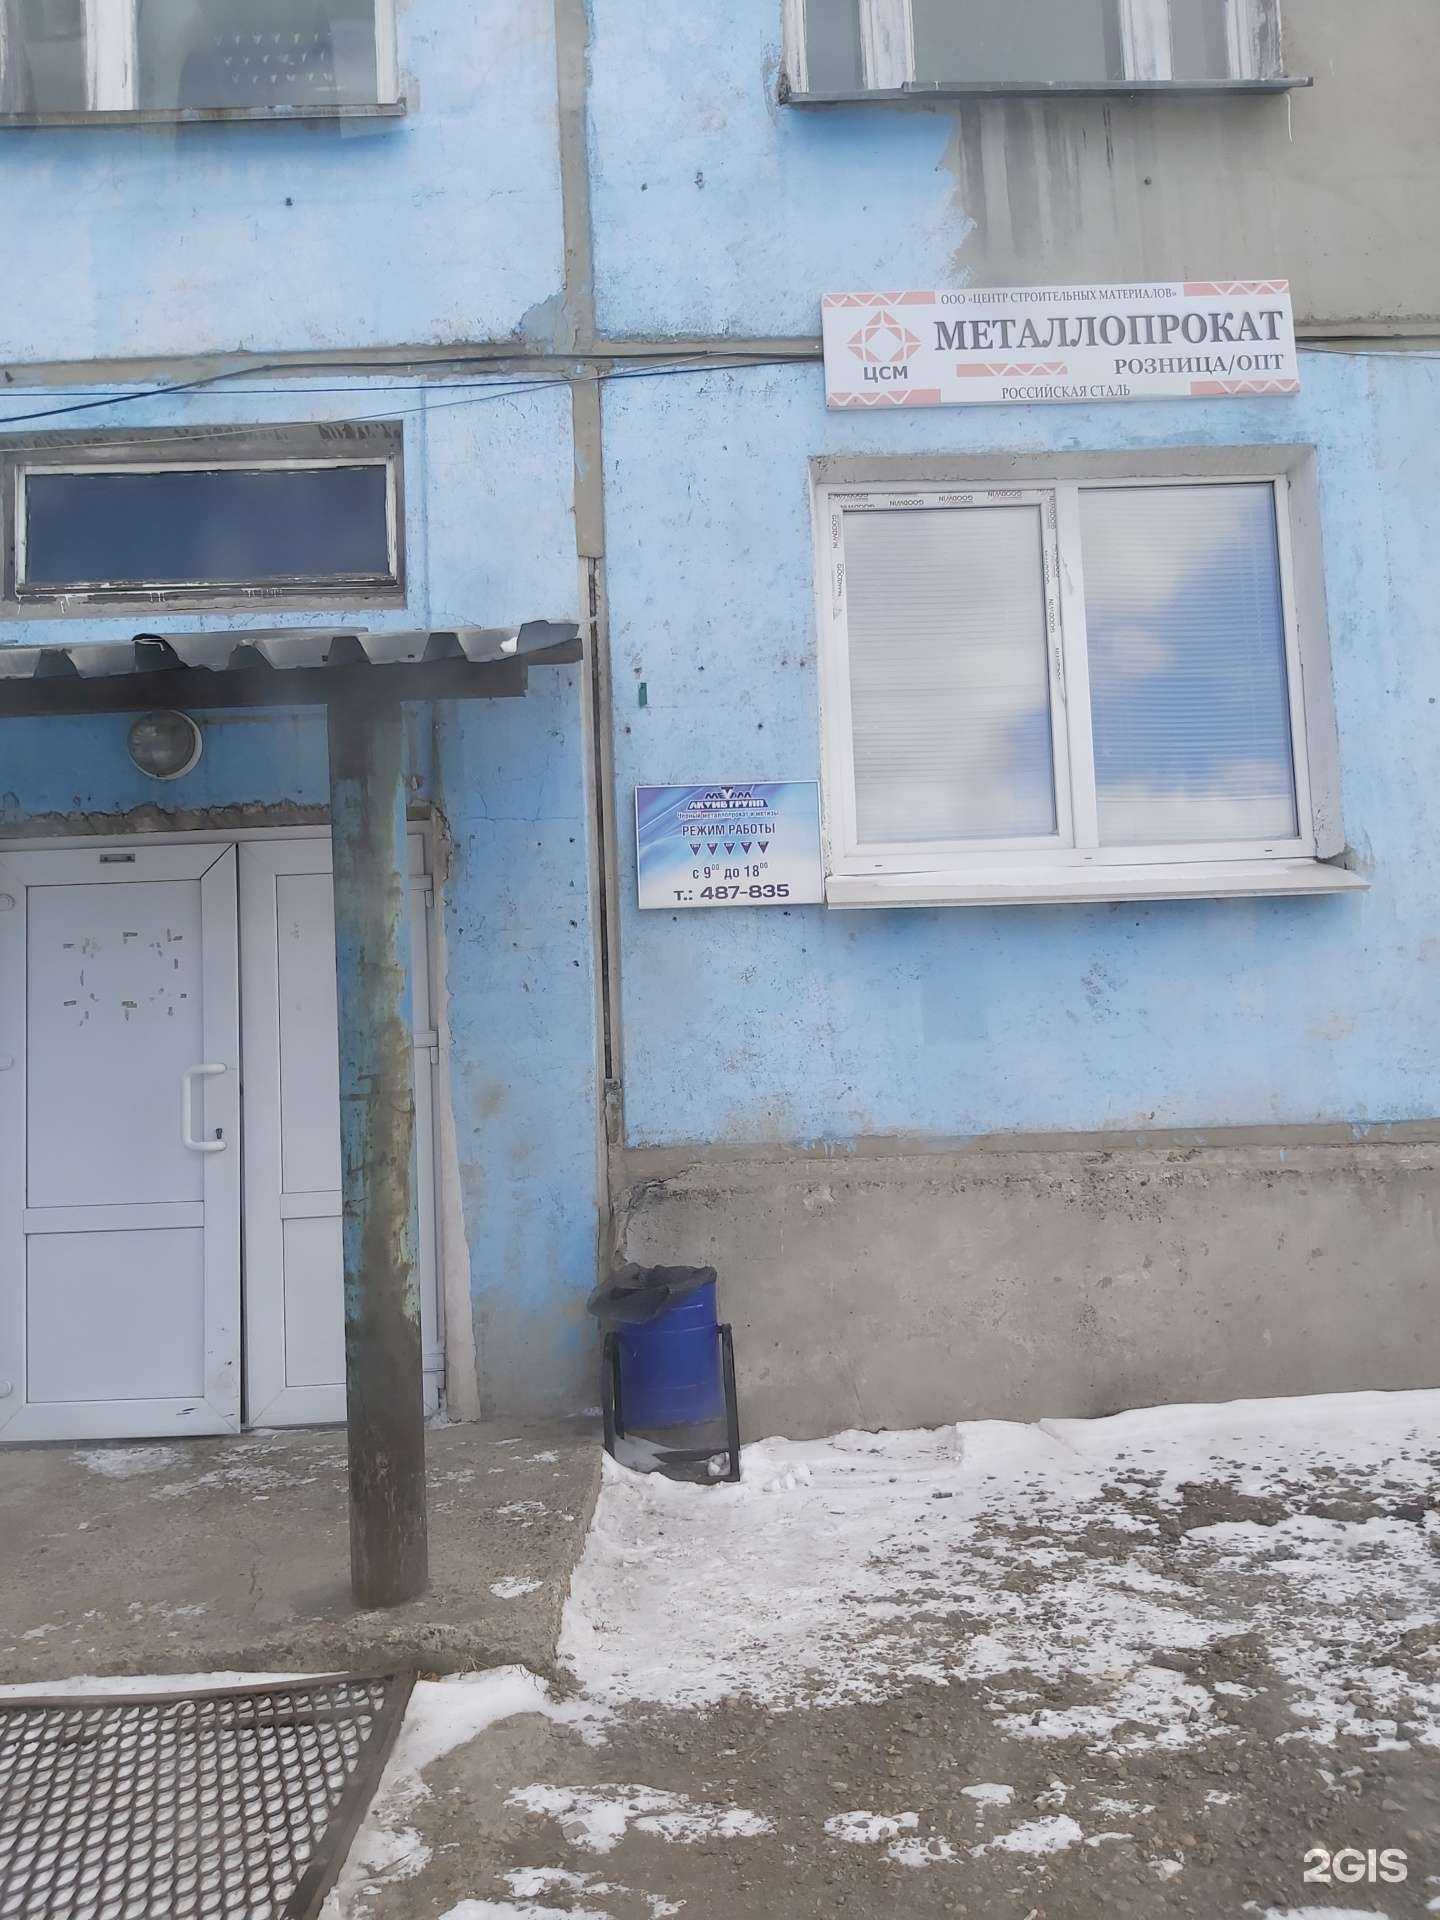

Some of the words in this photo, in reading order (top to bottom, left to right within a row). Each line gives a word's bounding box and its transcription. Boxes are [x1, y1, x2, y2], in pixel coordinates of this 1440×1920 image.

[940, 294, 967, 305] ООО
[968, 292, 1009, 306] «ЦЕНТР
[1010, 289, 1097, 303] СТРОИТЕЛЬНЫХ
[933, 310, 1284, 351] МЕТАЛЛОПРОКАТ
[1113, 353, 1285, 376] РОЗНИЦА/ОПТ
[863, 366, 909, 383] ЦСМ
[1001, 385, 1088, 400] РОССИЙСКАЯ
[1090, 383, 1131, 398] СТАЛЬ
[889, 499, 924, 507] GOODWIN
[682, 824, 725, 837] РЕЖИМ
[729, 823, 776, 835] РАБОТЫ
[724, 867, 740, 880] до
[699, 883, 790, 900] 487-835
